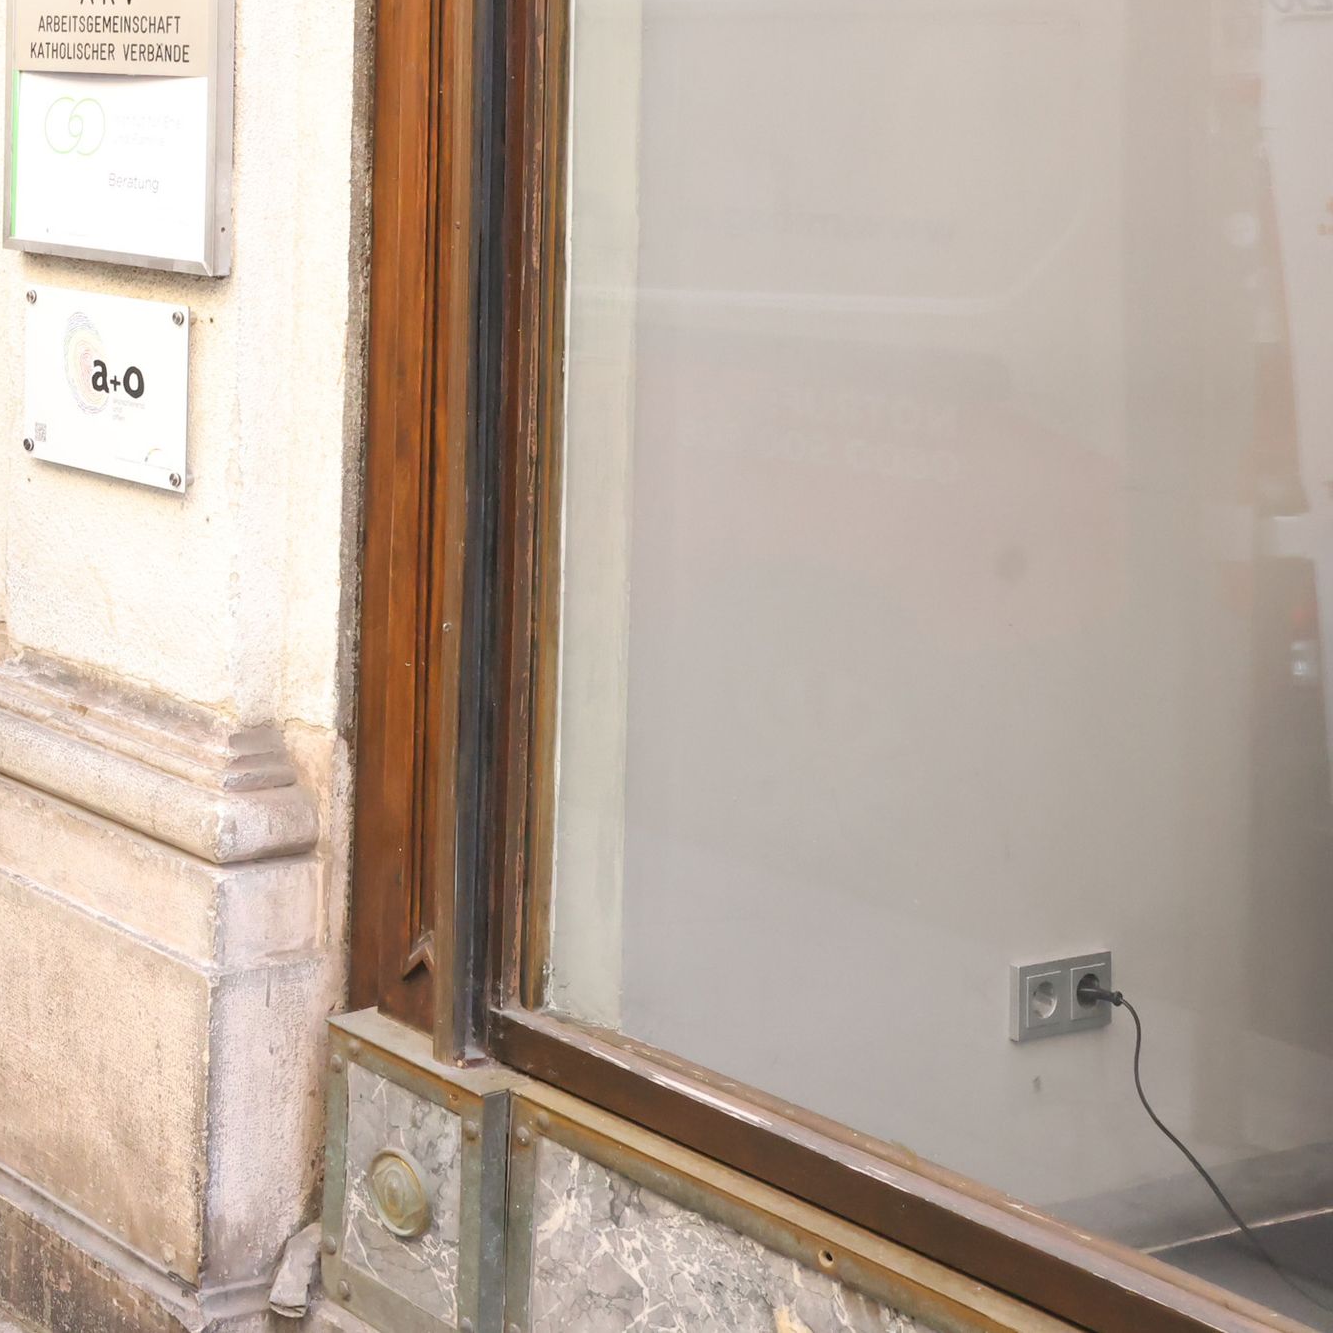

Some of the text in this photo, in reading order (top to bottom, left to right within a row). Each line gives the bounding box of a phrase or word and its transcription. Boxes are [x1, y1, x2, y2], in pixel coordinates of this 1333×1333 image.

[38, 15, 181, 35] ARBEITSGEMEINSCHAFT
[30, 42, 190, 63] KATHOLISCHER VERBÄNDE
[108, 172, 160, 195] Beratung
[91, 359, 146, 398] a+o
